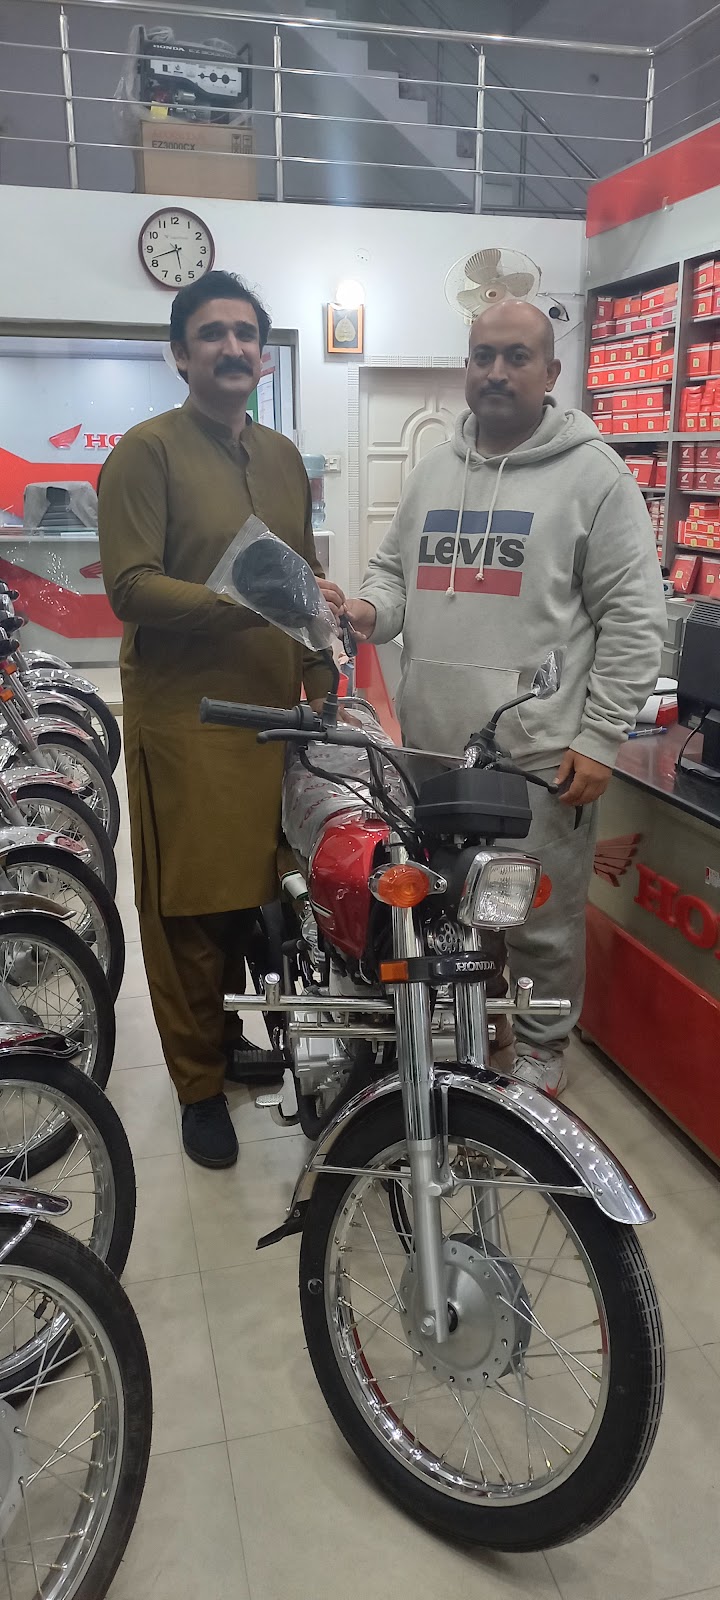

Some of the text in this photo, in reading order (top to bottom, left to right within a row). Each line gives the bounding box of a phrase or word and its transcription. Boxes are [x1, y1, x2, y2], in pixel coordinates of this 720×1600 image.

[153, 44, 185, 52] HONDA
[158, 220, 166, 229] 11
[171, 216, 180, 225] 12
[188, 221, 191, 229] 1
[149, 231, 159, 239] 10
[195, 231, 202, 240] 2
[146, 245, 154, 253] 9
[200, 246, 207, 255] 3
[151, 259, 159, 268] 8
[196, 260, 204, 268] 4
[162, 270, 169, 278] 7
[174, 274, 182, 283] 6
[187, 270, 195, 279] 5
[634, 863, 720, 955] HO
[455, 960, 496, 972] HONDA
